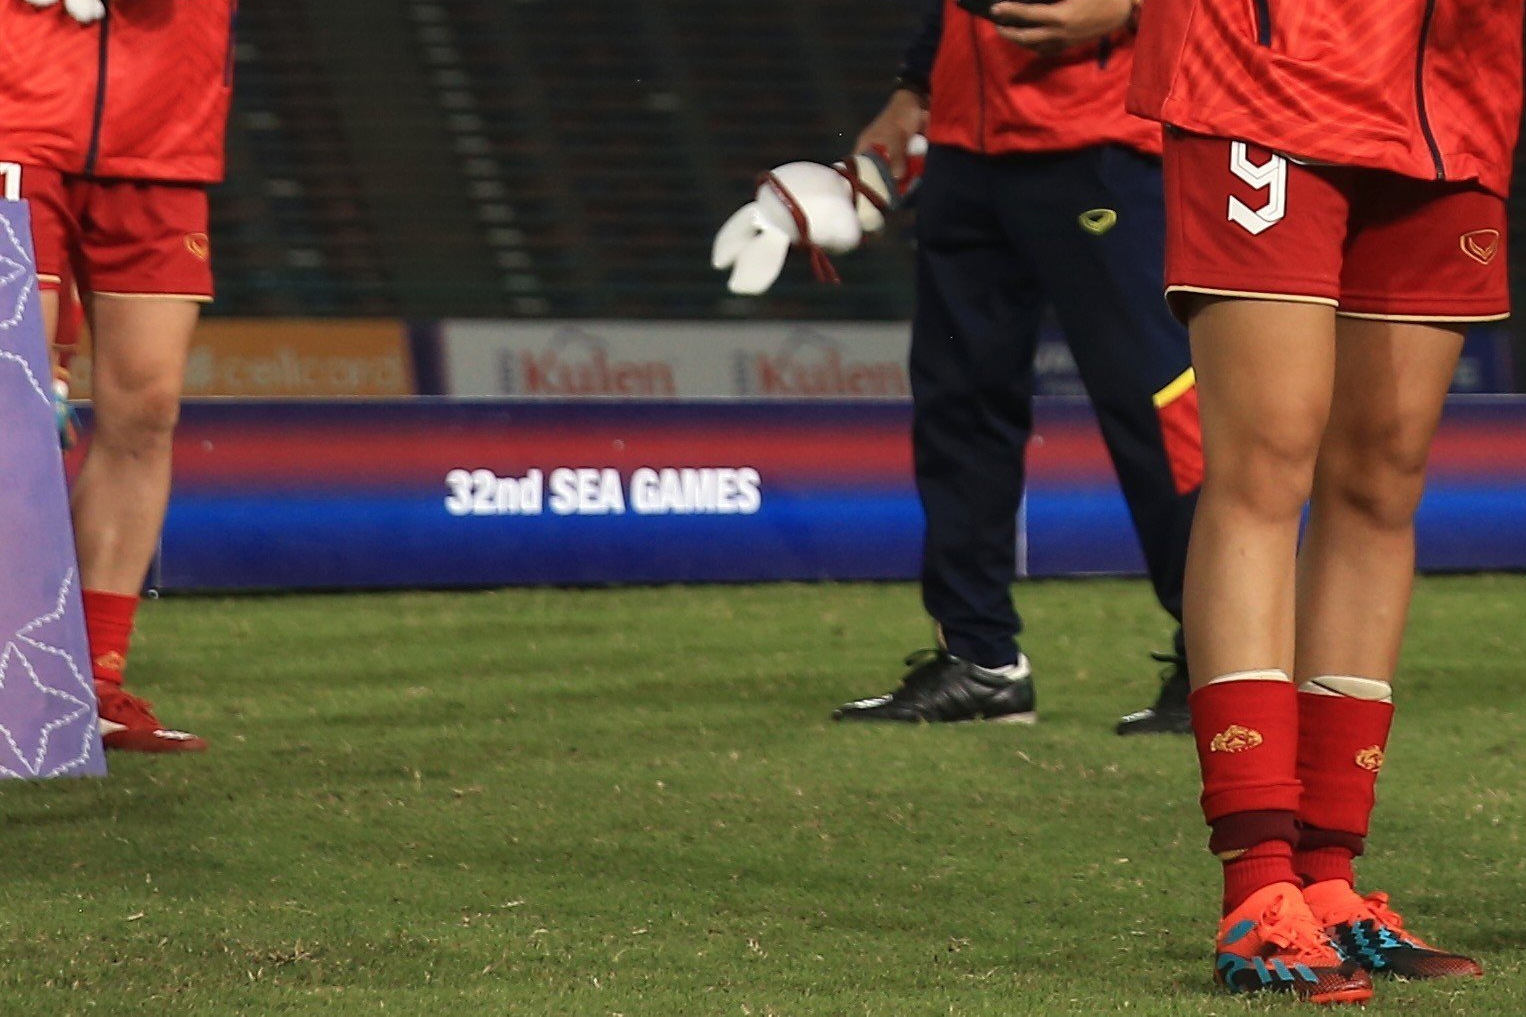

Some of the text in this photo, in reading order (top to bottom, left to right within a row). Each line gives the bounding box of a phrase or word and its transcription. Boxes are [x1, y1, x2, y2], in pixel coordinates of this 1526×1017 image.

[1227, 140, 1287, 236] 9
[520, 344, 677, 397] Kulen
[444, 467, 762, 516] 32nd SEA GAMES
